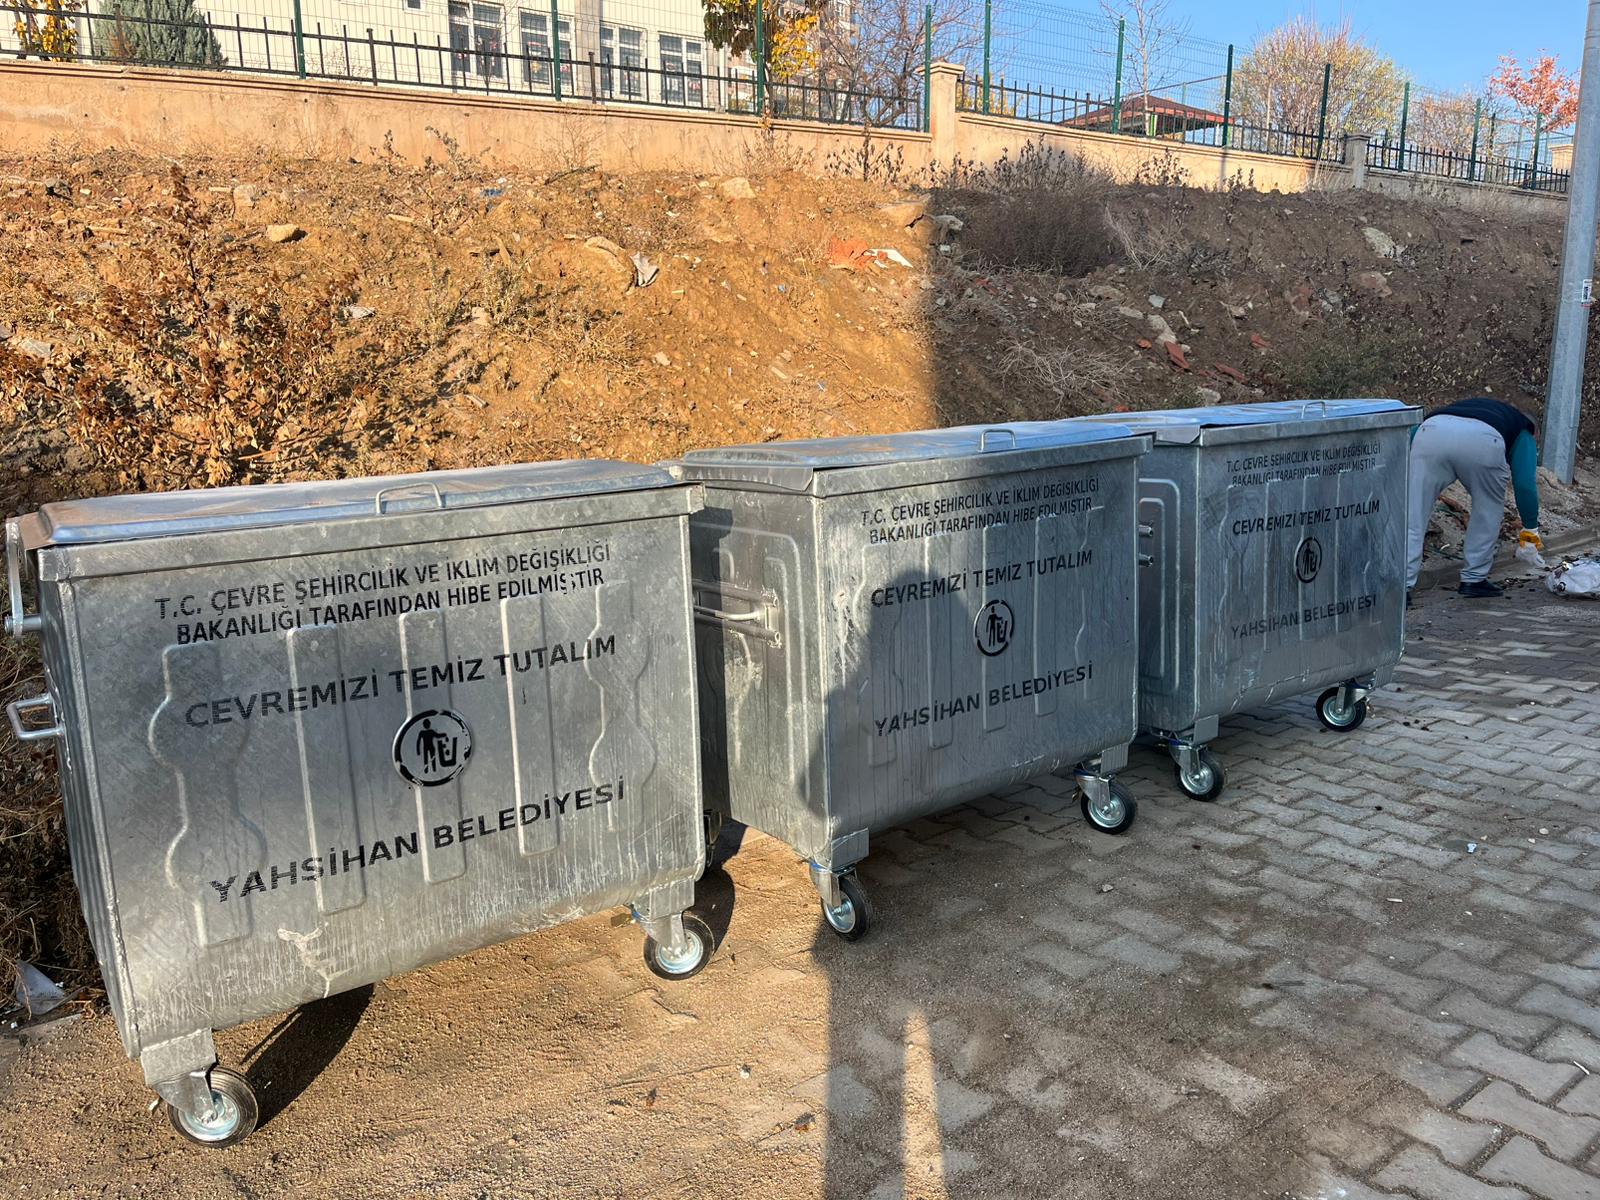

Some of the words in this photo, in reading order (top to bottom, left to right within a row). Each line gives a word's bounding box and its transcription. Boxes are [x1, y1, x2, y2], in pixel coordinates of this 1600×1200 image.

[1310, 449, 1320, 462] VE
[861, 509, 887, 526] T.C.
[891, 502, 930, 525] ÇEVRE
[996, 490, 1009, 506] VE
[940, 511, 1010, 534] TARAFINDAN
[1334, 499, 1380, 520] TUTALIM
[154, 595, 202, 619] T.C.
[210, 583, 285, 615] ÇEVRE
[294, 563, 408, 605] ŞEHİRCİLİK
[414, 564, 440, 582] VE
[446, 553, 499, 581] İKLİM
[507, 539, 611, 574] DEĞİŞİKLİĞİ
[973, 561, 1022, 587] TEMİZ
[1026, 550, 1092, 577] TUTALIM
[177, 605, 301, 645] BAKANLIĞI
[309, 590, 440, 626] TARAFINDAN
[389, 655, 485, 692] TEMİZ
[493, 635, 616, 676] TUTALIM
[433, 775, 624, 849] BELEDİYESİ
